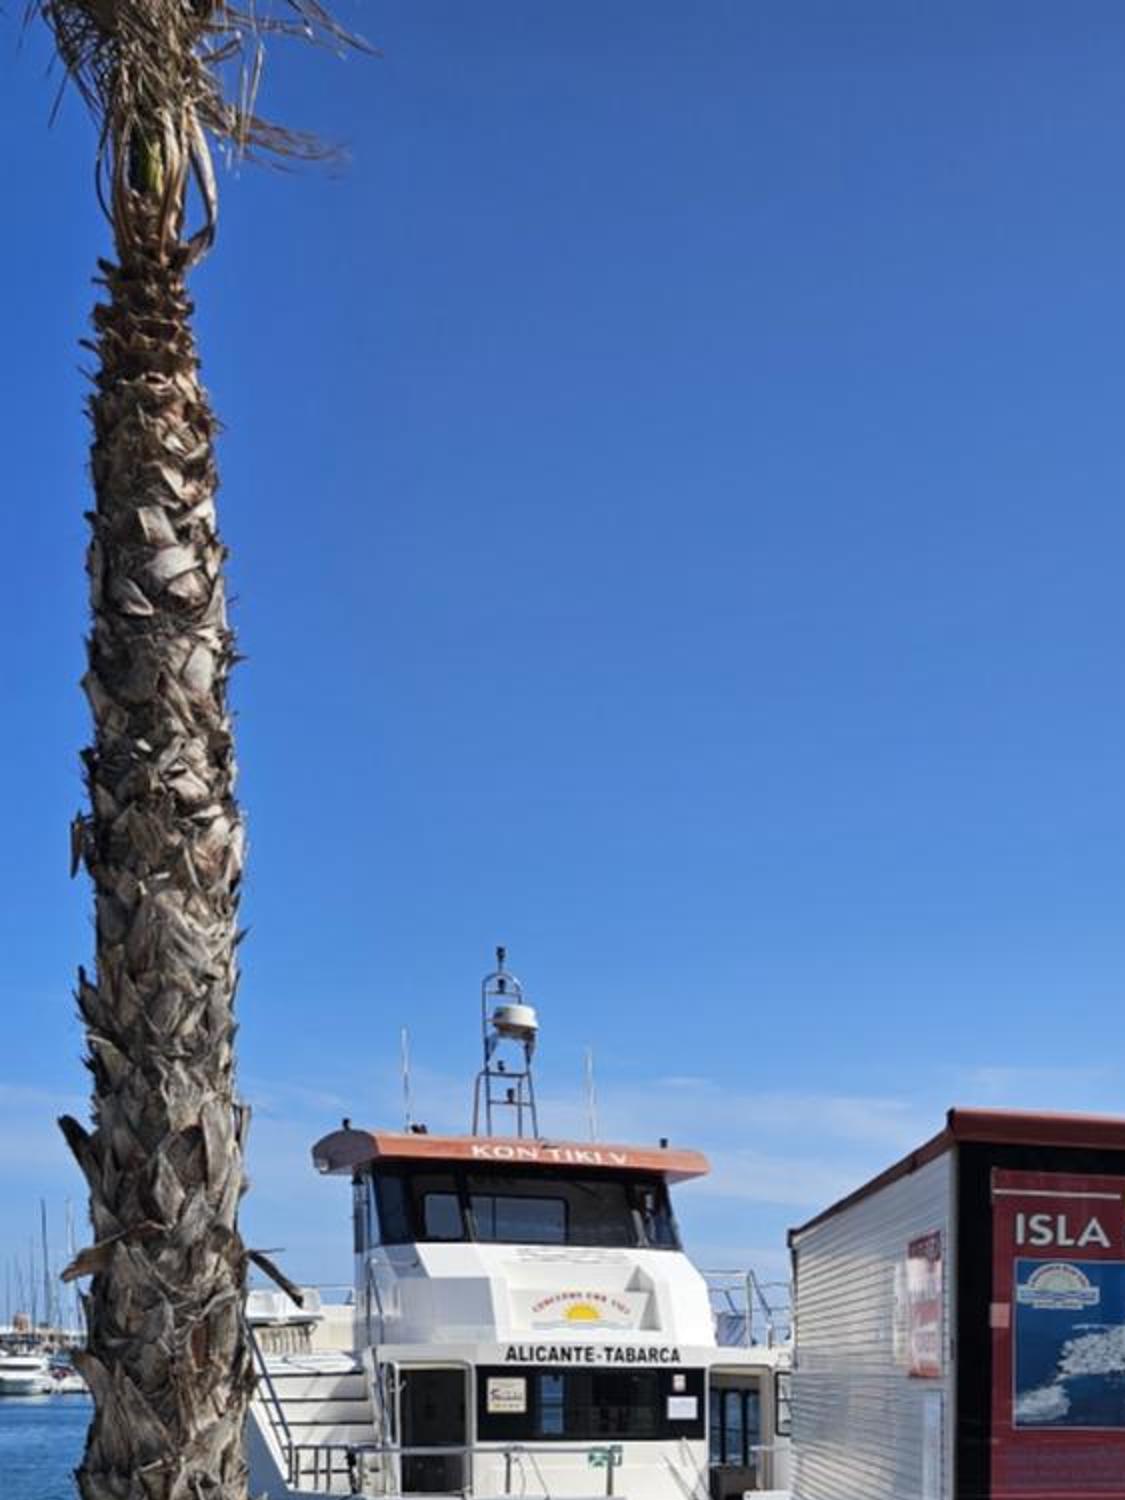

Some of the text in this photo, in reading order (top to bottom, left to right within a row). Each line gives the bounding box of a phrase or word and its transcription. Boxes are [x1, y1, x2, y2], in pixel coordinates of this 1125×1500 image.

[471, 1145, 539, 1161] KON
[543, 1148, 604, 1165] TIKI
[1016, 1213, 1111, 1248] ISLA
